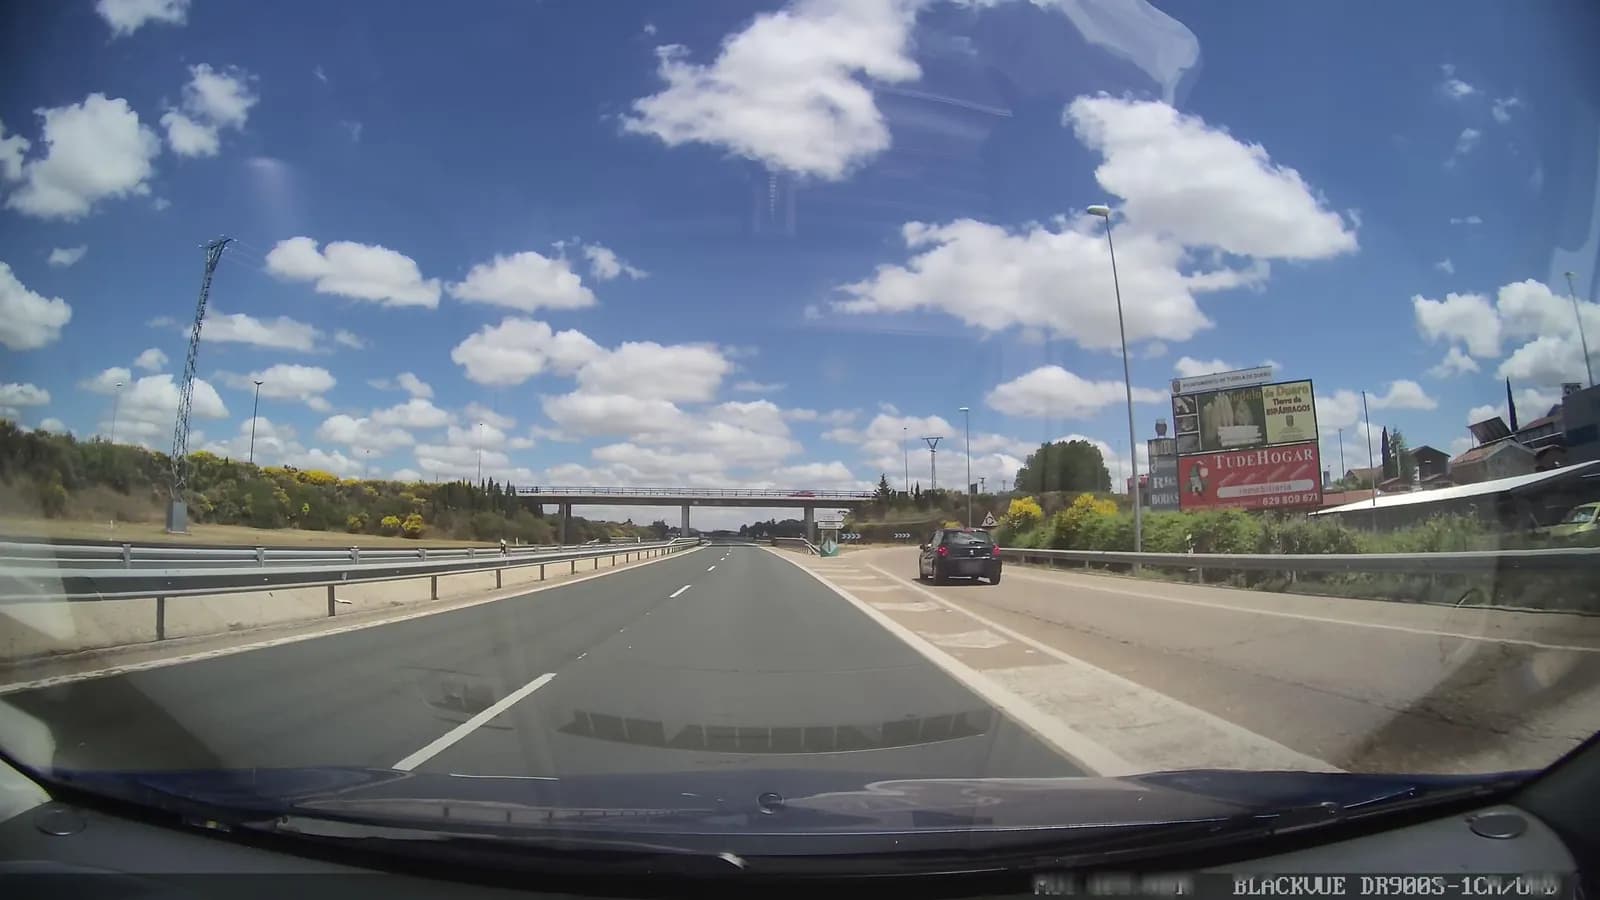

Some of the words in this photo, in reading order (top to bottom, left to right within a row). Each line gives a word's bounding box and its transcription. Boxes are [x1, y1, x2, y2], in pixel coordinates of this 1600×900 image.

[1273, 398, 1292, 406] Tierra
[1262, 497, 1280, 506] 629
[1302, 492, 1318, 502] 671
